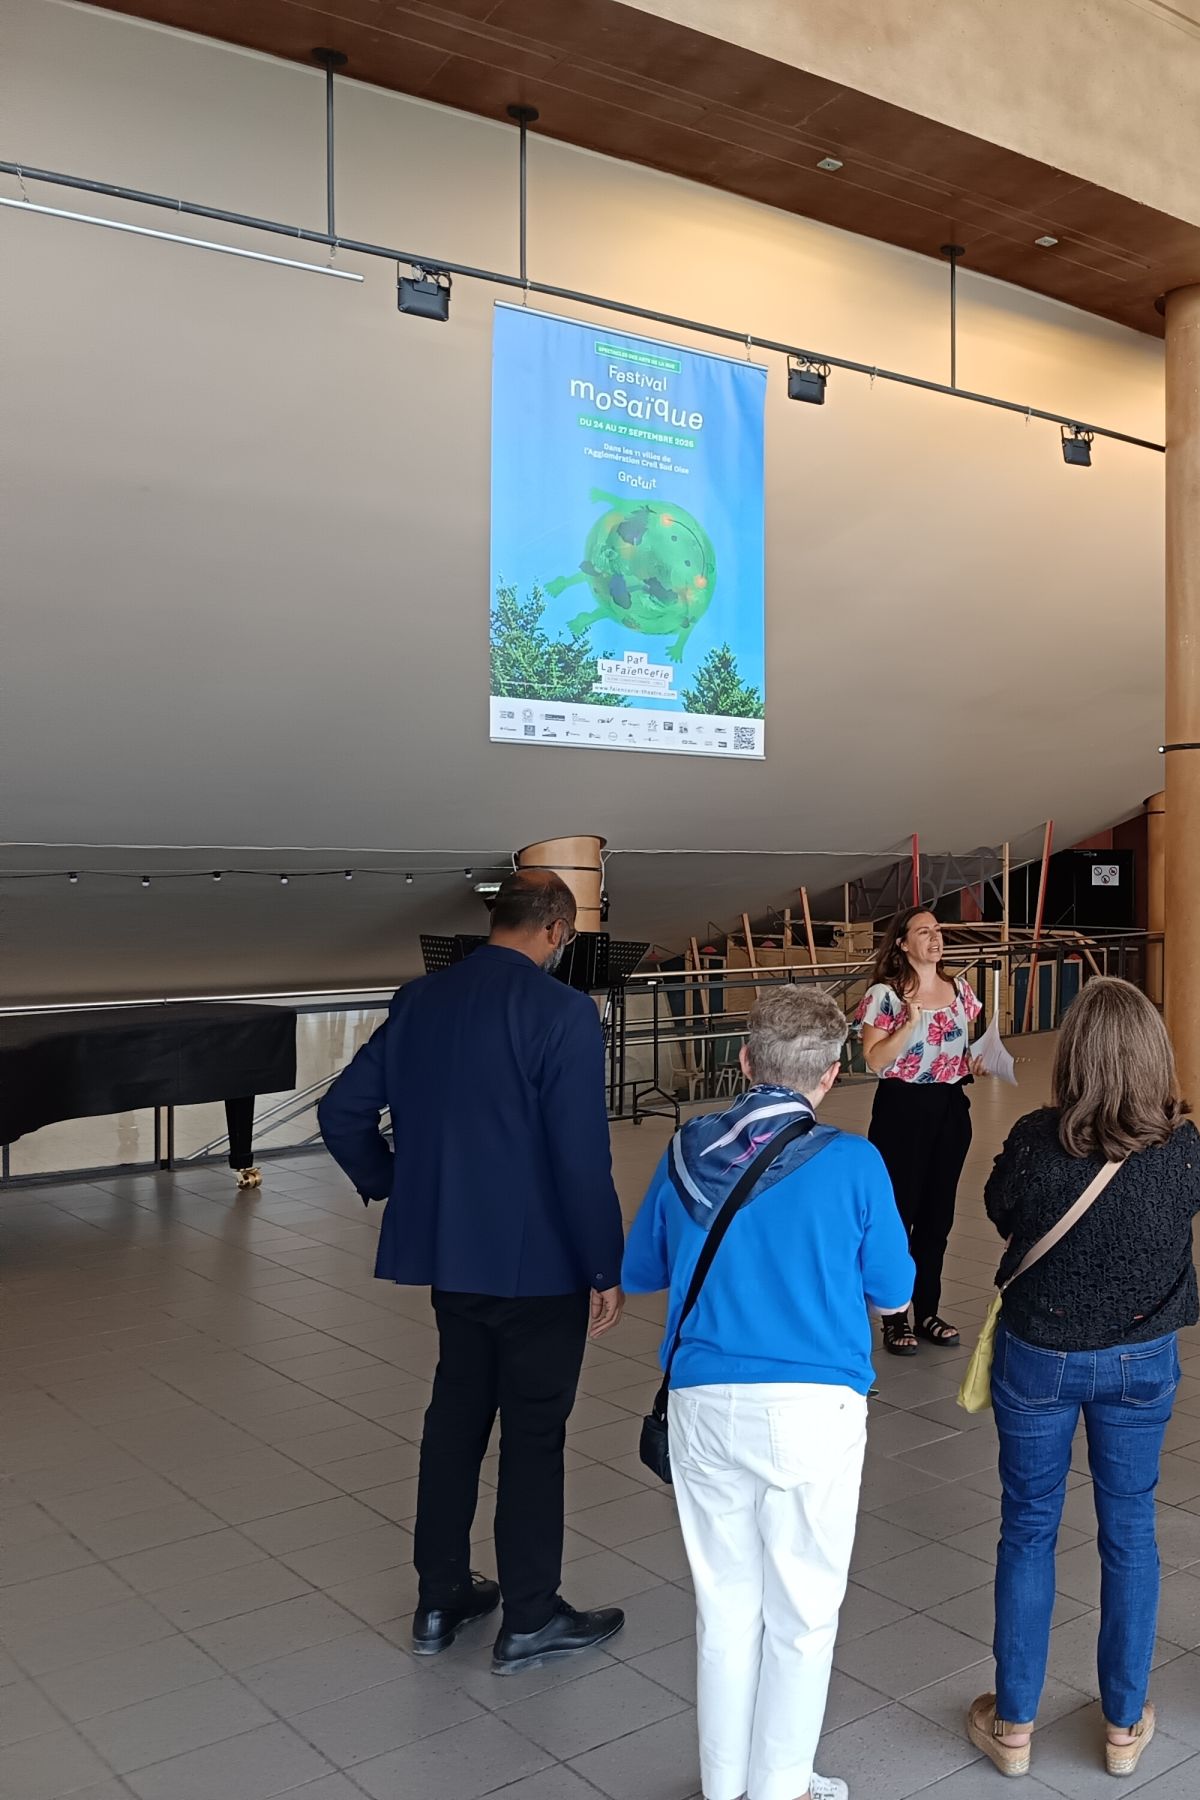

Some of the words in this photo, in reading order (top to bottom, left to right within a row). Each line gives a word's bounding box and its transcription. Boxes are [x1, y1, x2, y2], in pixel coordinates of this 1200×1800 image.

[609, 364, 667, 392] Festival
[570, 379, 704, 430] mosaïque
[580, 418, 592, 427] DU
[593, 420, 604, 429] 24
[605, 423, 617, 432] AU
[617, 425, 628, 435] 27
[628, 428, 674, 445] SEPTEMBRE
[603, 443, 621, 453] Dans
[622, 446, 633, 456] les
[641, 450, 661, 461] villes
[662, 455, 672, 463] de
[641, 459, 658, 469] Creil
[658, 462, 673, 472] Sud
[673, 465, 689, 475] Oise
[617, 470, 657, 490] Gratuit
[627, 655, 644, 665] Par
[601, 663, 613, 674] La
[615, 664, 670, 680] Faïencerie
